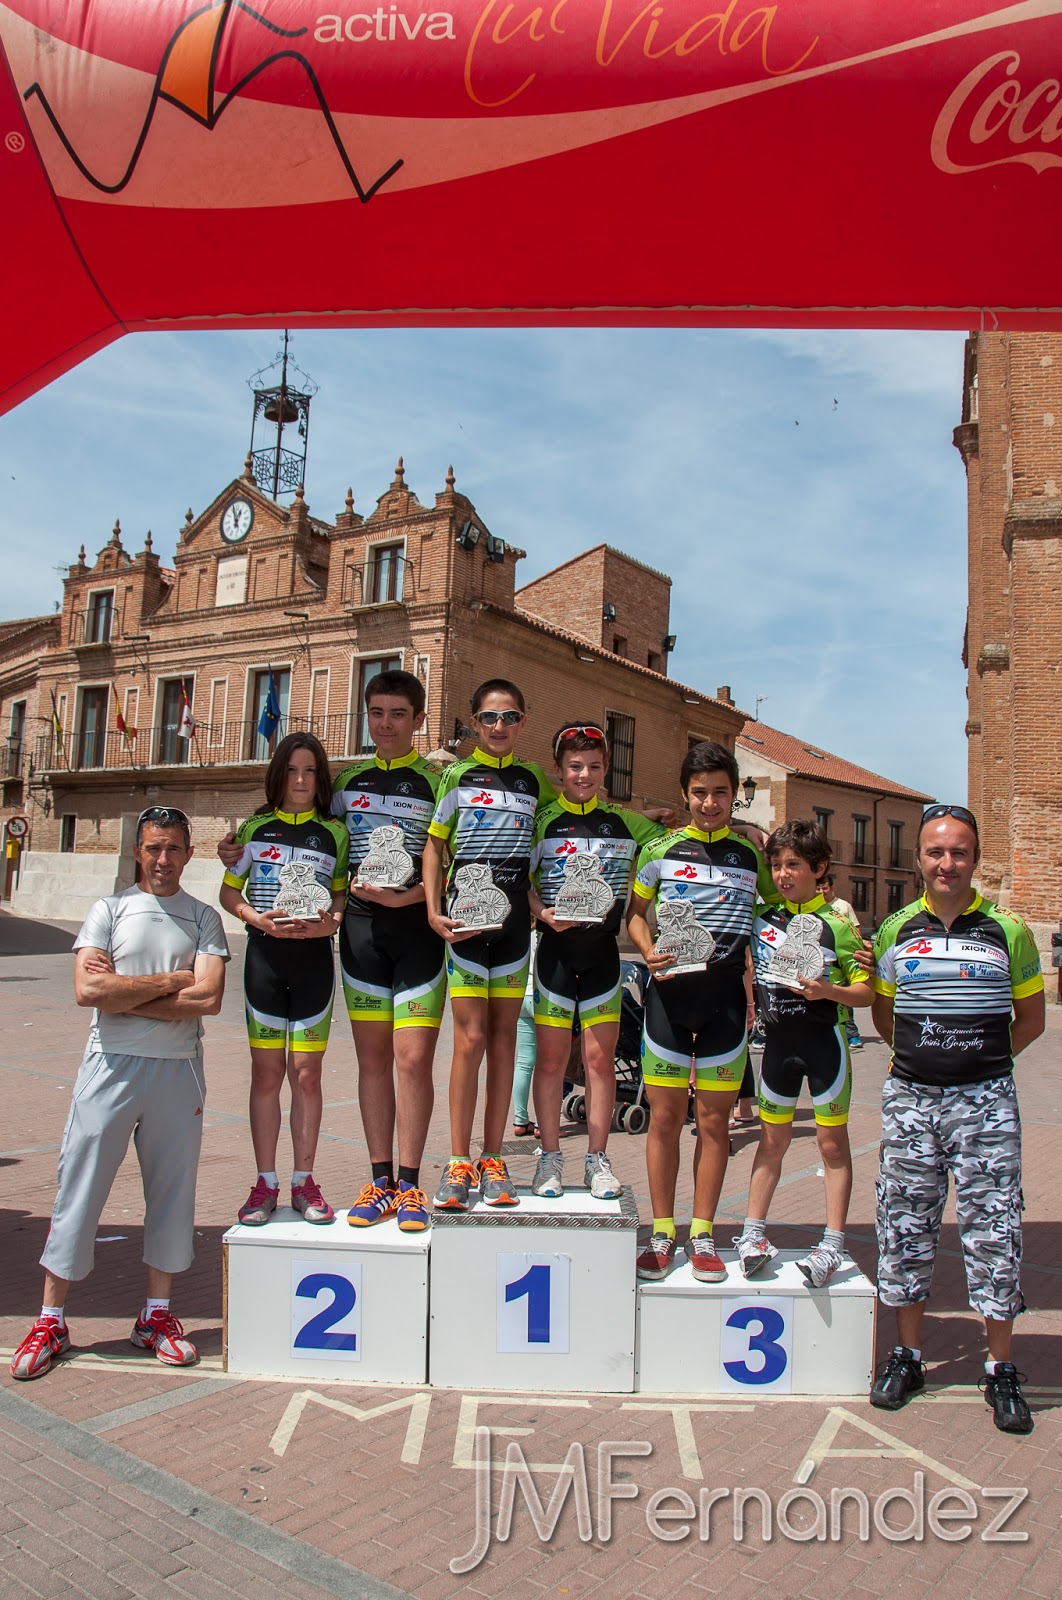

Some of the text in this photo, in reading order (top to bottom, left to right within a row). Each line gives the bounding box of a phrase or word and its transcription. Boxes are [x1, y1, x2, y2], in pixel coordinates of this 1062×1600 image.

[313, 5, 456, 43] activa
[595, 0, 820, 75] Vida
[393, 801, 429, 813] IXION bikes
[301, 853, 320, 863] IXION
[721, 871, 754, 883] IXION bikes
[961, 944, 987, 953] IXION
[293, 1273, 357, 1352] 2
[504, 1265, 551, 1344] 1
[722, 1306, 789, 1385] 3
[268, 1389, 983, 1491] META
